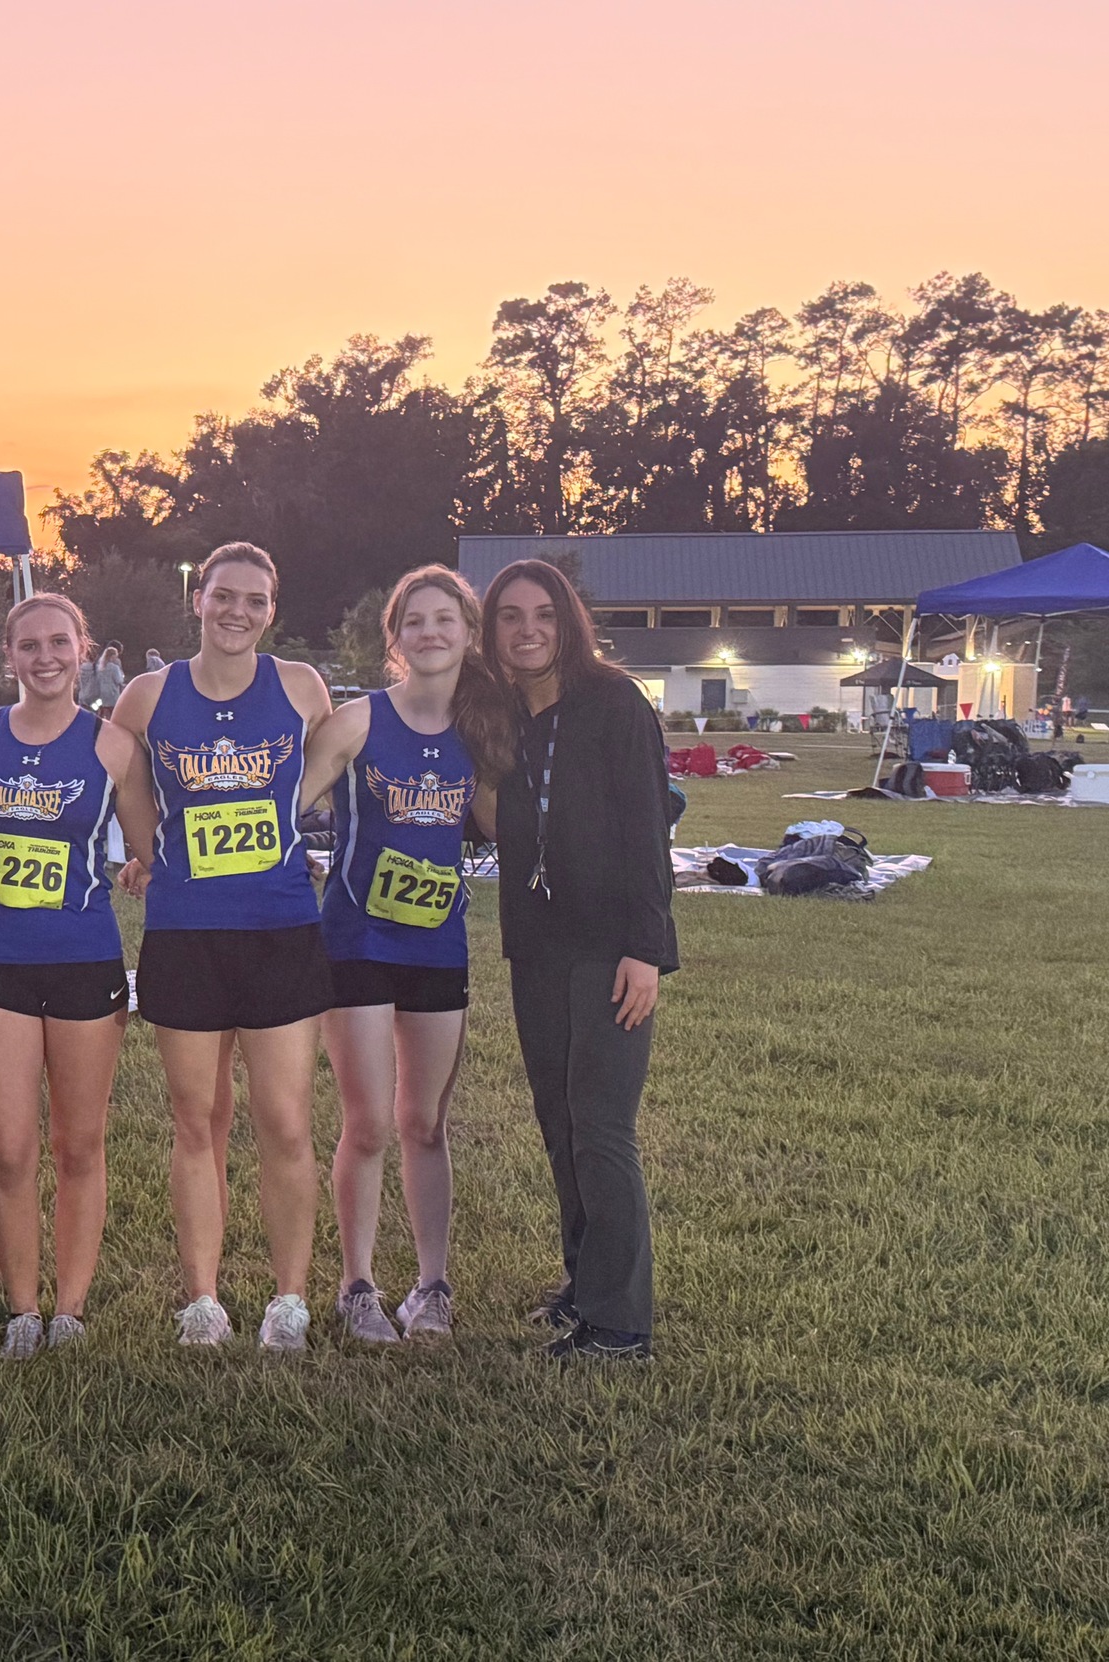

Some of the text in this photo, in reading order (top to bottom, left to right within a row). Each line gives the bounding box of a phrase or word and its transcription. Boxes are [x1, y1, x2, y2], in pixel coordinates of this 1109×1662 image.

[178, 749, 271, 782] TALLAHASSEE
[194, 811, 221, 821] HOKA
[387, 785, 465, 816] TALLAHASSEE
[192, 820, 277, 857] 1228
[387, 855, 414, 870] HOKA
[379, 870, 455, 910] 1225
